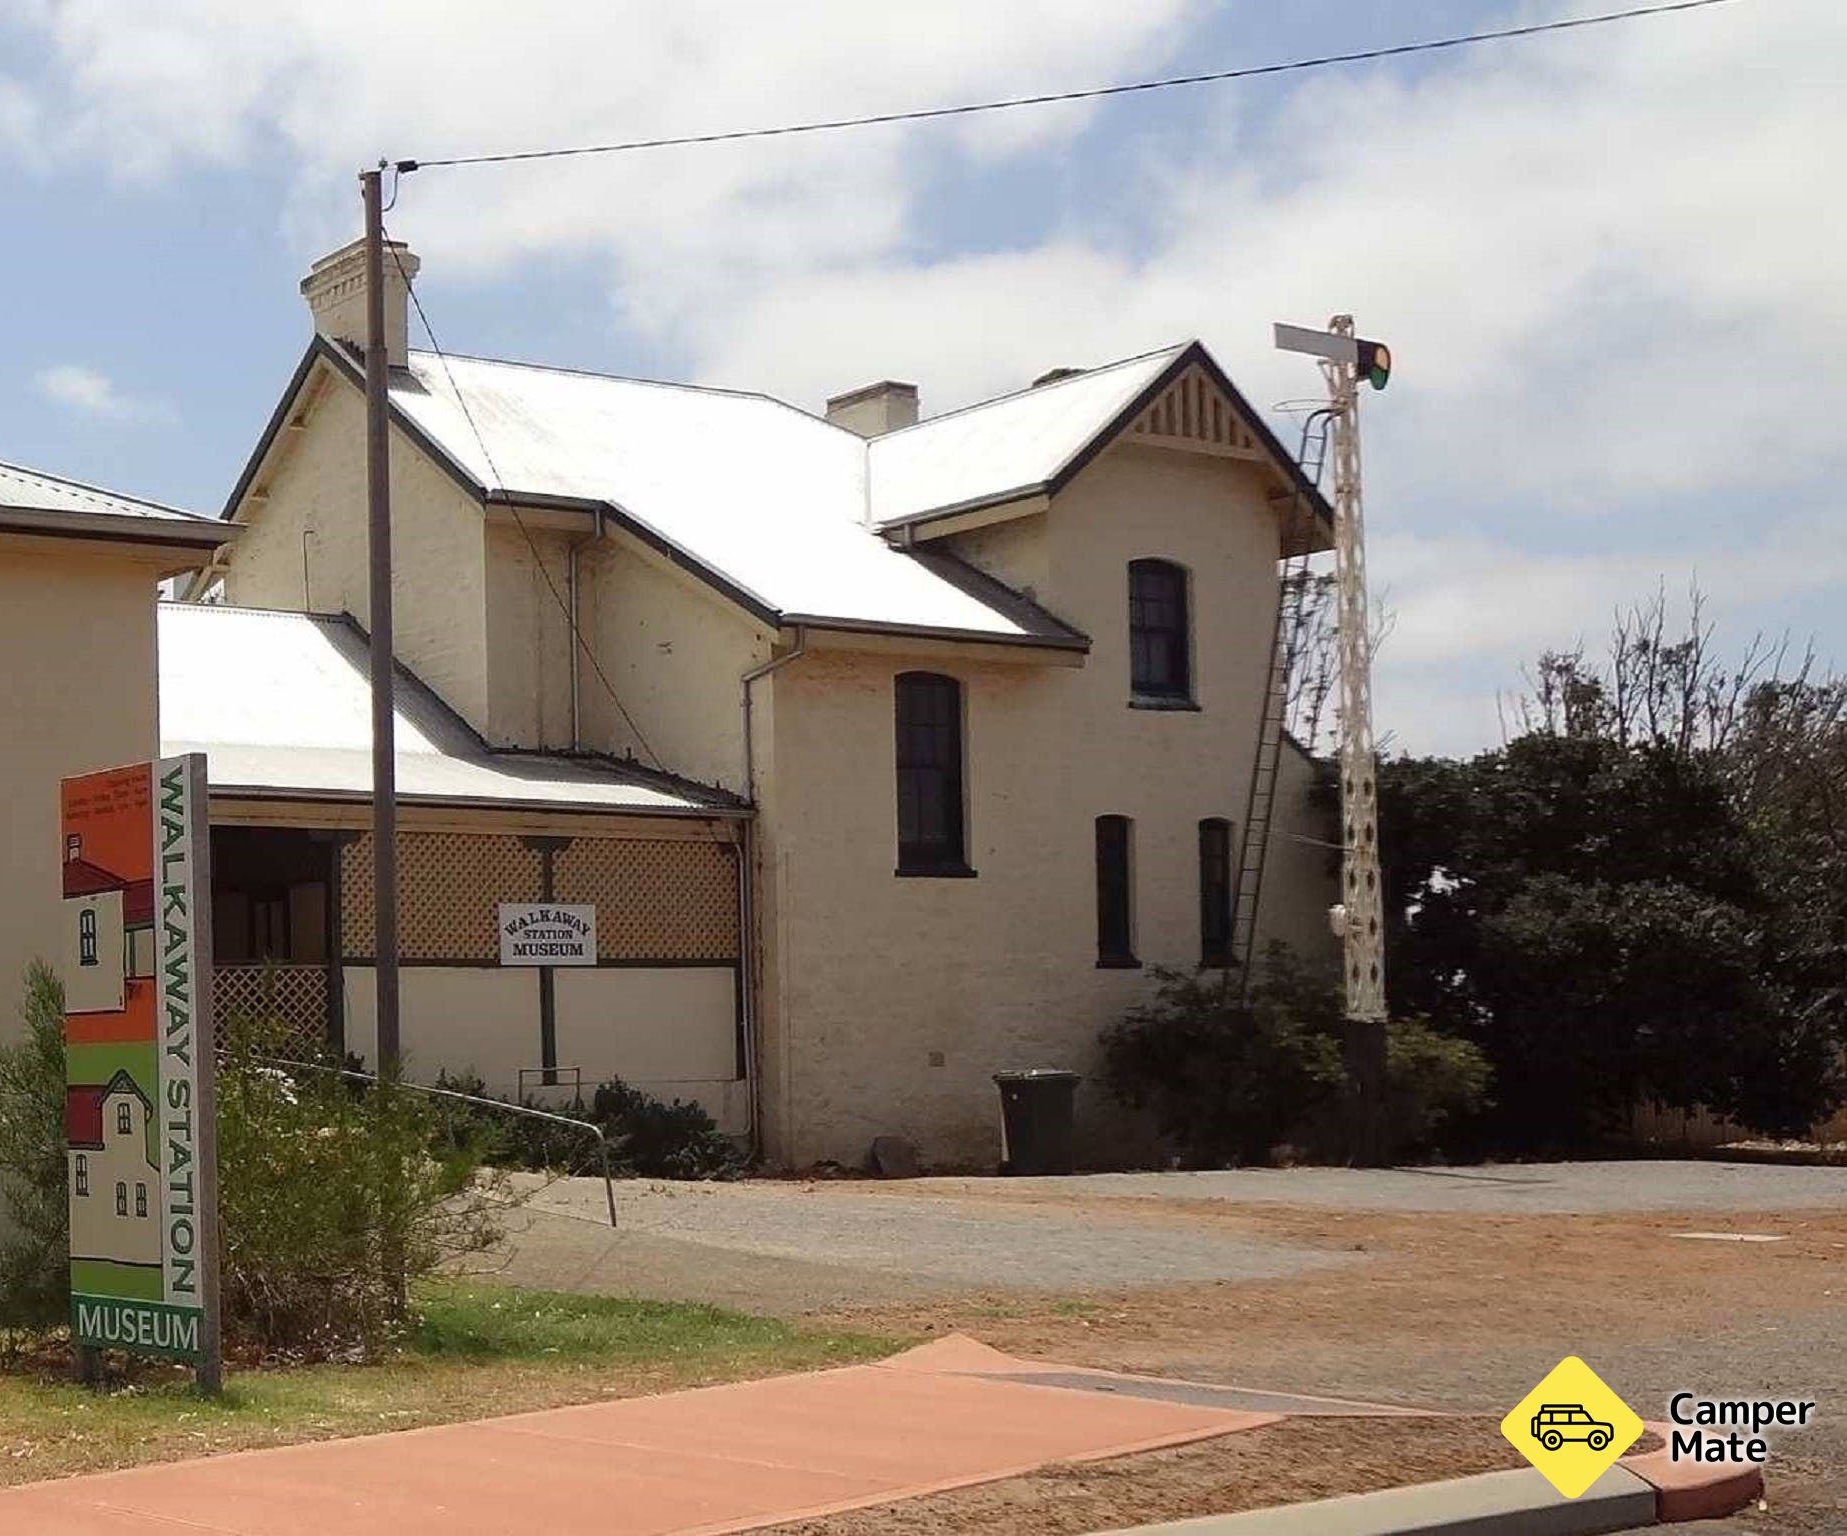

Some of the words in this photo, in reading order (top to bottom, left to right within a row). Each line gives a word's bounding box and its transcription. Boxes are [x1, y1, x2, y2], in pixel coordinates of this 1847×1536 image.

[160, 764, 190, 1067] WALKAWAY
[504, 909, 591, 936] WALKAWAY
[513, 943, 584, 956] MUSEUM
[523, 929, 573, 940] STATION
[167, 1079, 195, 1293] STATION
[78, 1303, 199, 1351] MUSEUM
